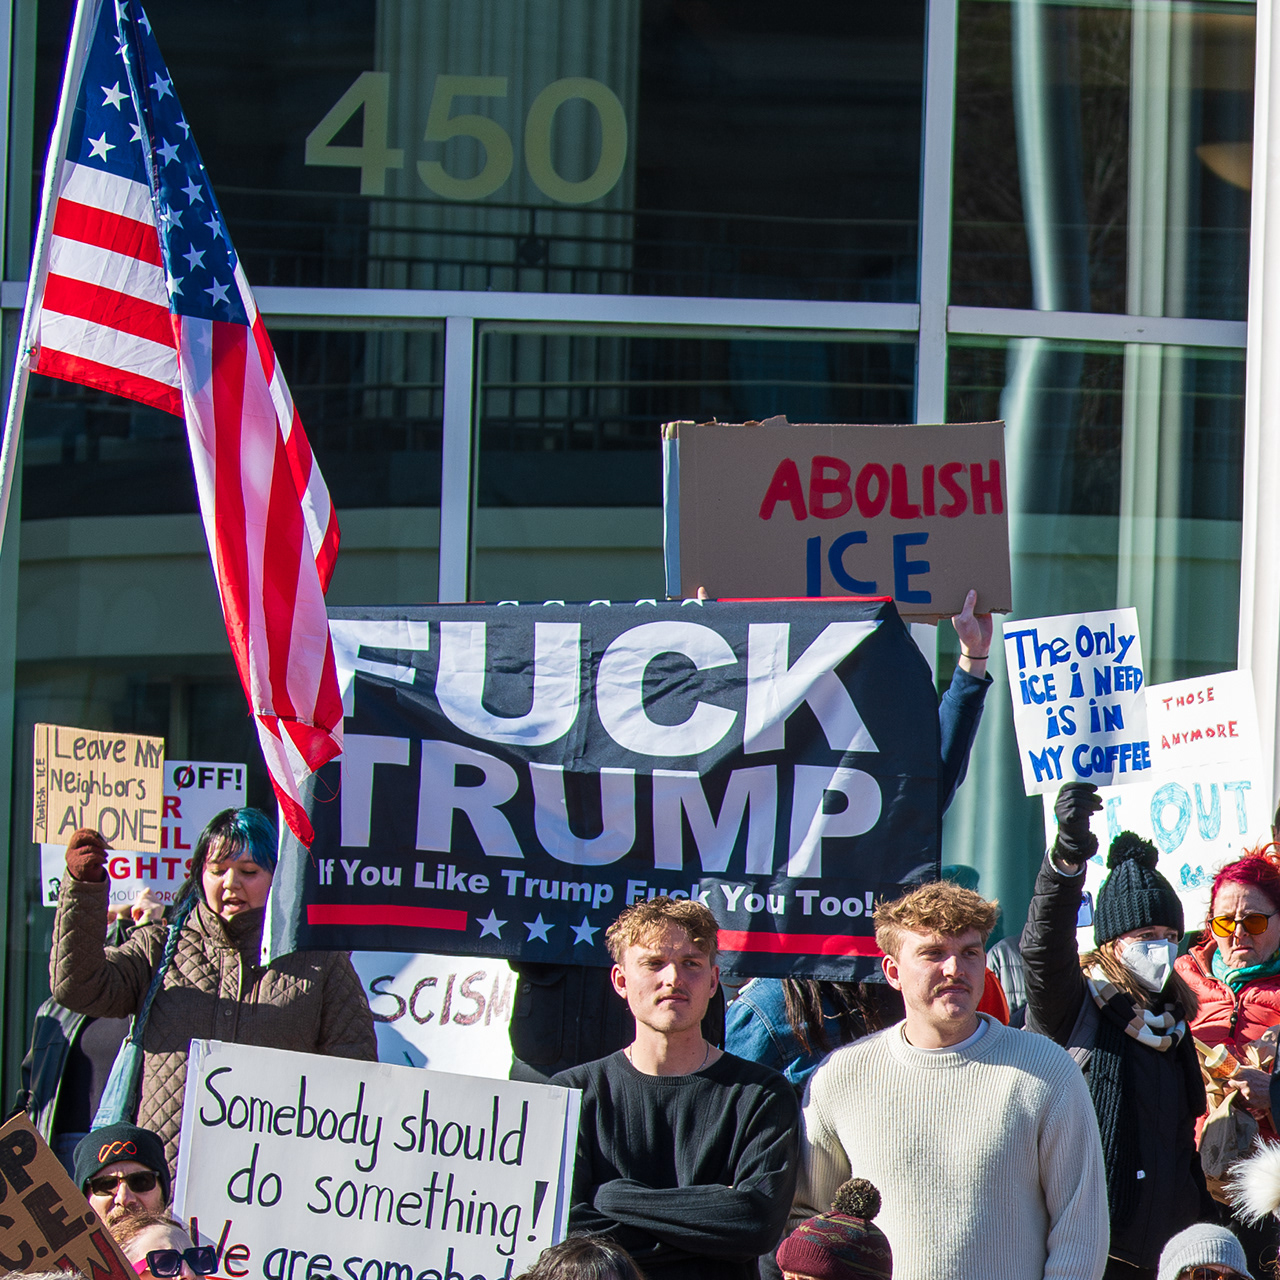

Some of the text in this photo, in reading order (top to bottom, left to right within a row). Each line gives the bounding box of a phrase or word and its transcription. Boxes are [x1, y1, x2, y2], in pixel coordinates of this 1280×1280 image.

[304, 70, 628, 203] 450
[758, 455, 1004, 522] ABOLISH
[805, 531, 932, 604] ICE
[1003, 622, 1136, 671] The Only
[327, 618, 884, 759] FUCK
[1093, 665, 1144, 698] NEED
[1162, 686, 1216, 712] THOSE
[54, 727, 127, 764] Leave
[1028, 741, 1152, 783] MY COFFEE
[1160, 720, 1240, 750] ANYMORE
[36, 757, 46, 778] ICE
[50, 768, 147, 807] Neighbors
[340, 733, 883, 877] TRUMP
[1150, 780, 1252, 855] OUT
[318, 859, 874, 918] If You Like Trump You Too!
[199, 1066, 529, 1172] Somebody should
[227, 1142, 549, 1255] do something!
